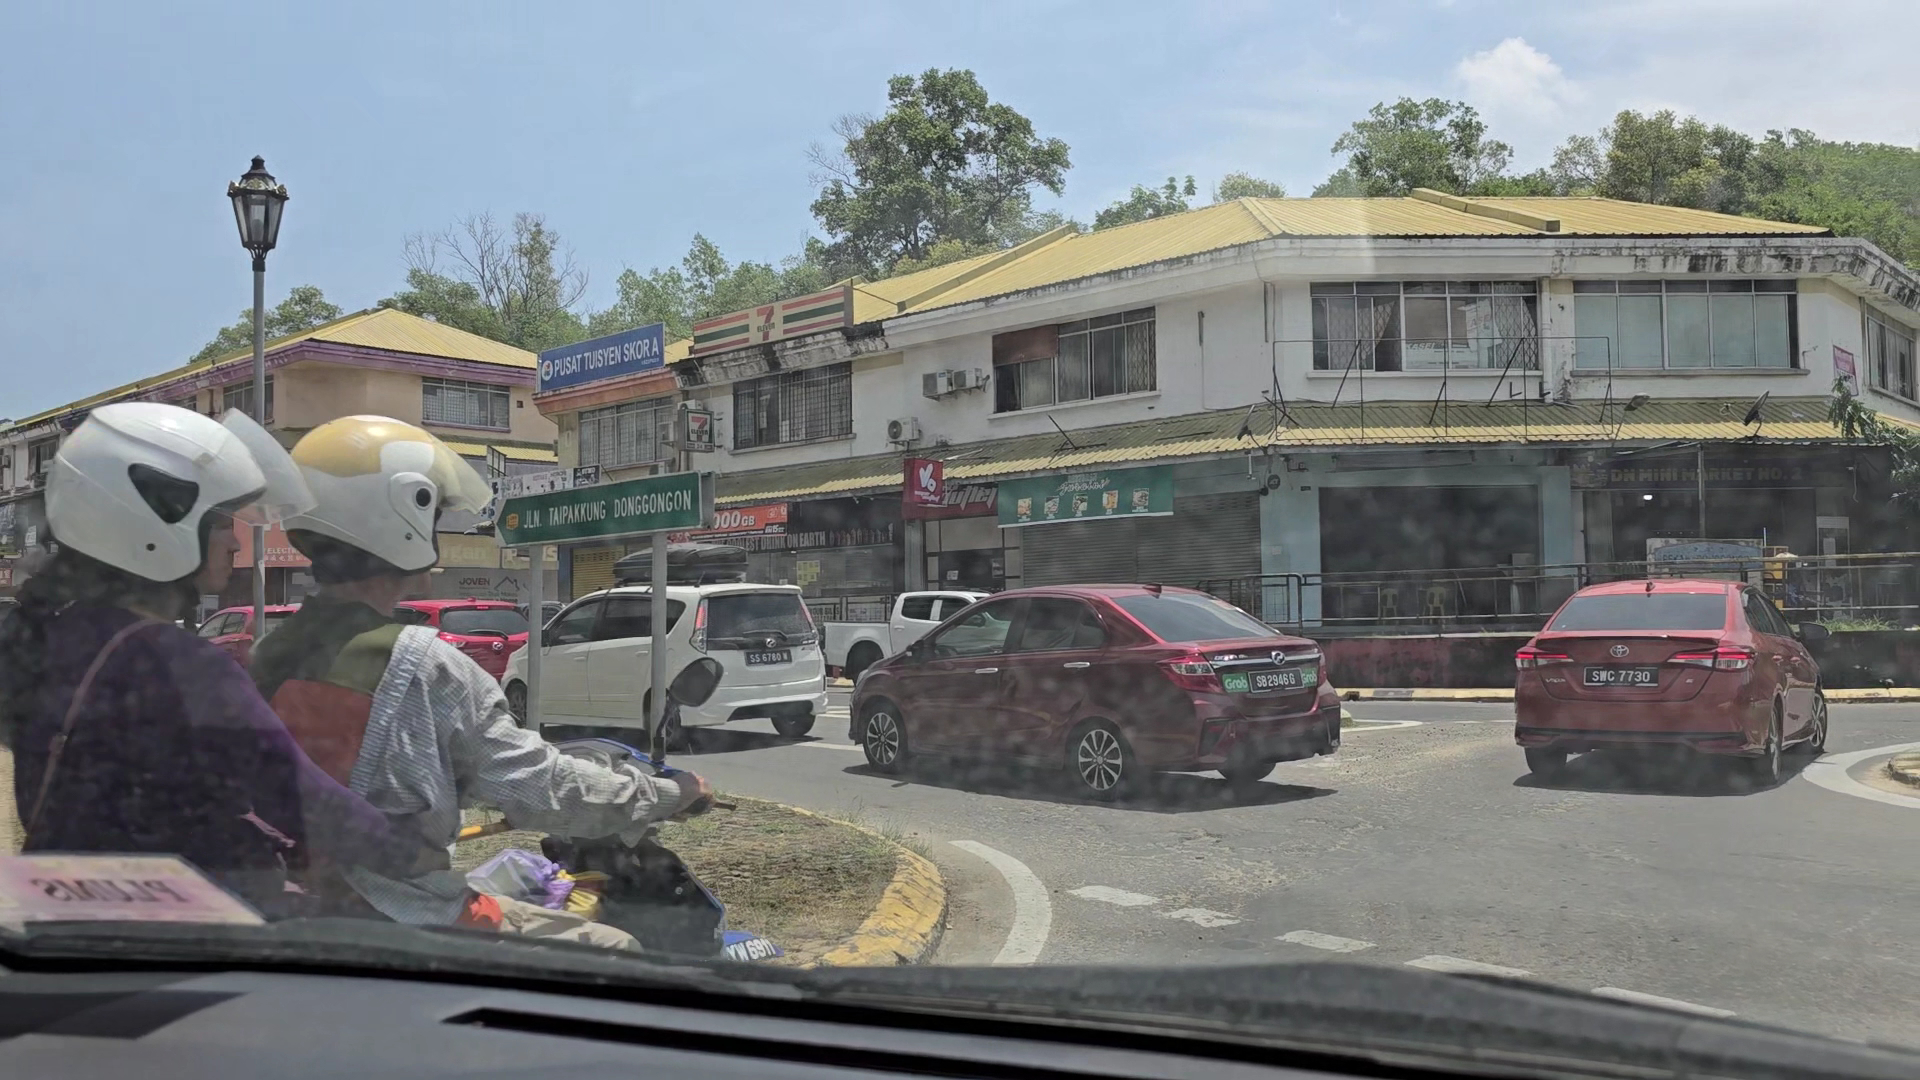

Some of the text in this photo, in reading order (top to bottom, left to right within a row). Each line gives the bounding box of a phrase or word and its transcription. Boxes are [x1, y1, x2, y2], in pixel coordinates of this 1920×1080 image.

[757, 306, 774, 341] 7
[554, 354, 582, 377] PUSAT
[584, 344, 621, 370] TUISYEN
[691, 416, 707, 442] 7
[1682, 467, 1755, 481] MARKET
[1791, 466, 1802, 480] 2
[524, 509, 542, 529] JLN.
[549, 501, 606, 526] TAIPAKKUNG
[614, 489, 692, 519] DONGGONGON
[761, 535, 786, 550] DRINK
[787, 533, 798, 549] ON
[800, 531, 826, 546] EARTH
[459, 578, 490, 586] JOVEN
[750, 654, 760, 663] SS
[1224, 676, 1248, 690] Grab
[1302, 670, 1317, 684] Grab
[1592, 670, 1650, 682] SWC 7730
